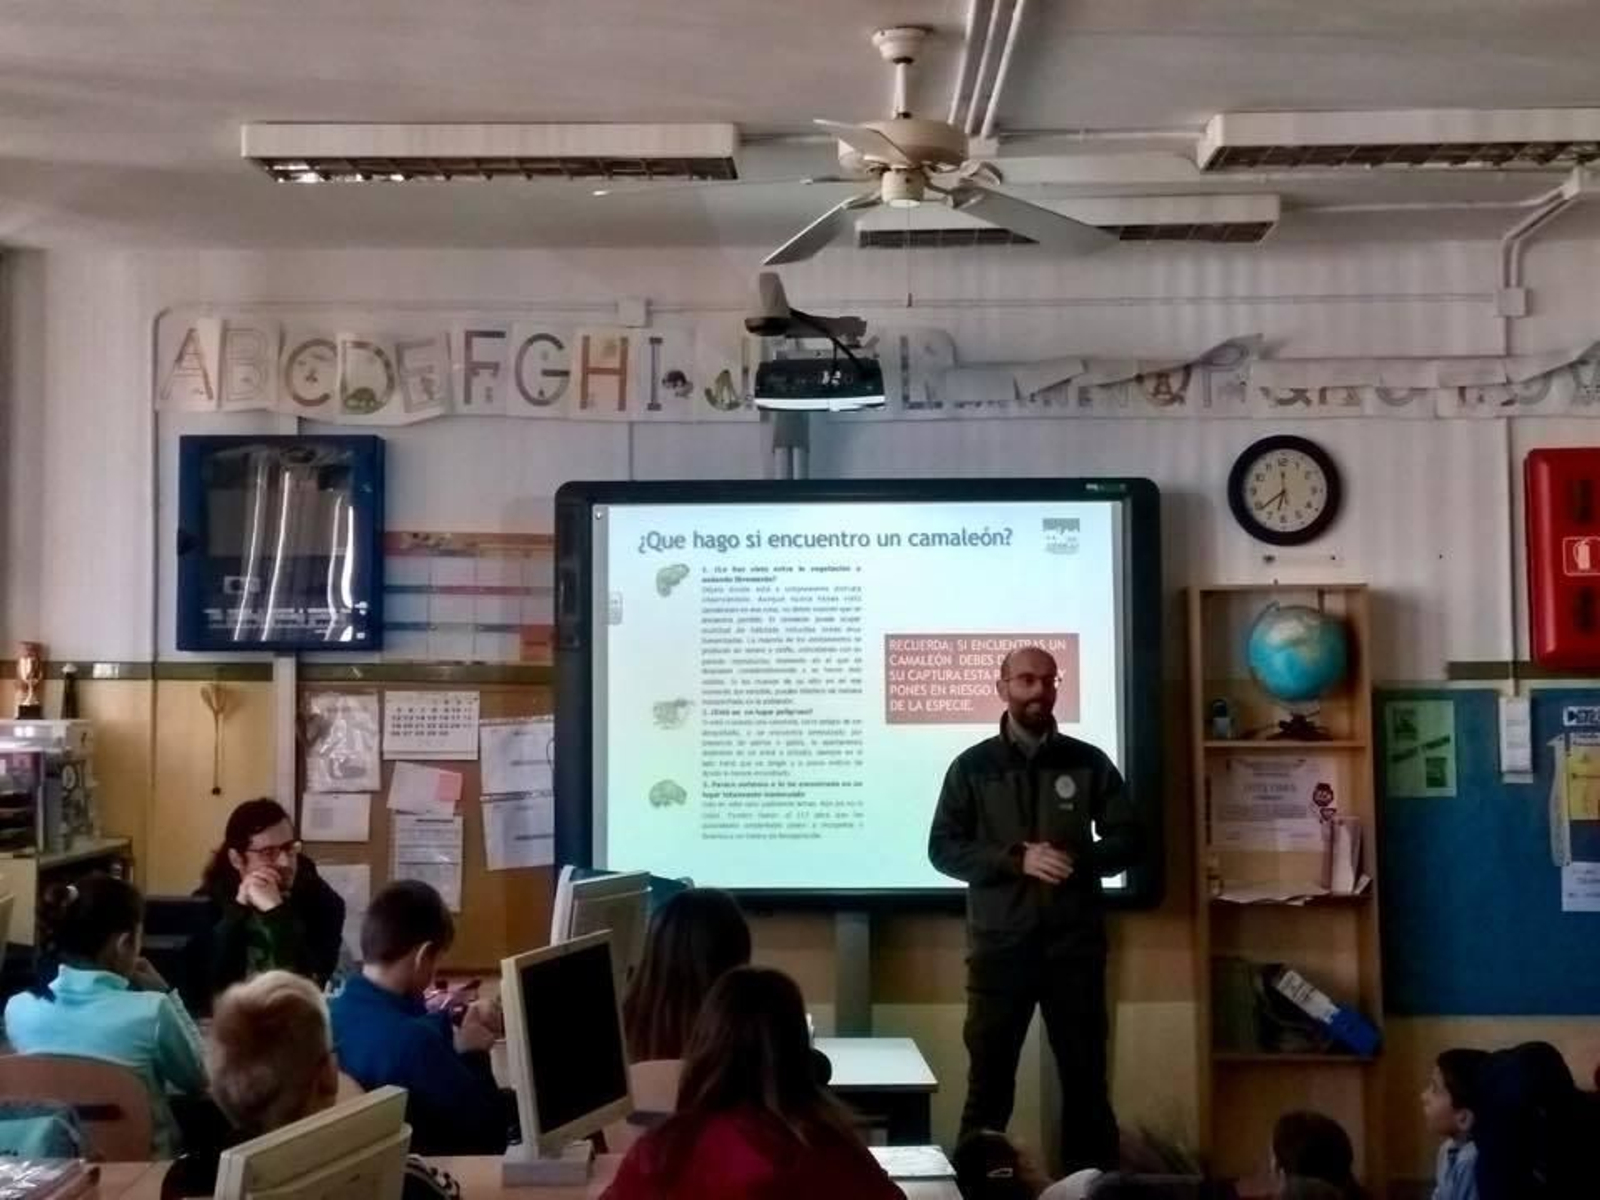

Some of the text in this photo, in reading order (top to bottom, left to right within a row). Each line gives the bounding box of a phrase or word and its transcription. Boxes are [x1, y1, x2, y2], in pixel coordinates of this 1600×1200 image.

[463, 330, 506, 405] F
[514, 332, 570, 407] G
[580, 335, 628, 411] H
[693, 530, 740, 552] hago
[746, 530, 761, 548] si
[768, 531, 871, 548] encuentro
[877, 532, 901, 547] un
[908, 527, 1013, 548] camaleón?
[957, 639, 967, 651] SI
[1050, 640, 1066, 650] UN
[889, 654, 952, 666] CAMALEÓN
[959, 654, 994, 666] DEBES
[889, 669, 905, 681] SU
[907, 669, 962, 681] CAPTURA
[964, 669, 992, 681] ESTA
[890, 684, 927, 696] PONES
[930, 684, 947, 696] EN
[950, 684, 991, 696] RIESGO
[890, 700, 904, 712] DE
[908, 700, 923, 712] LA
